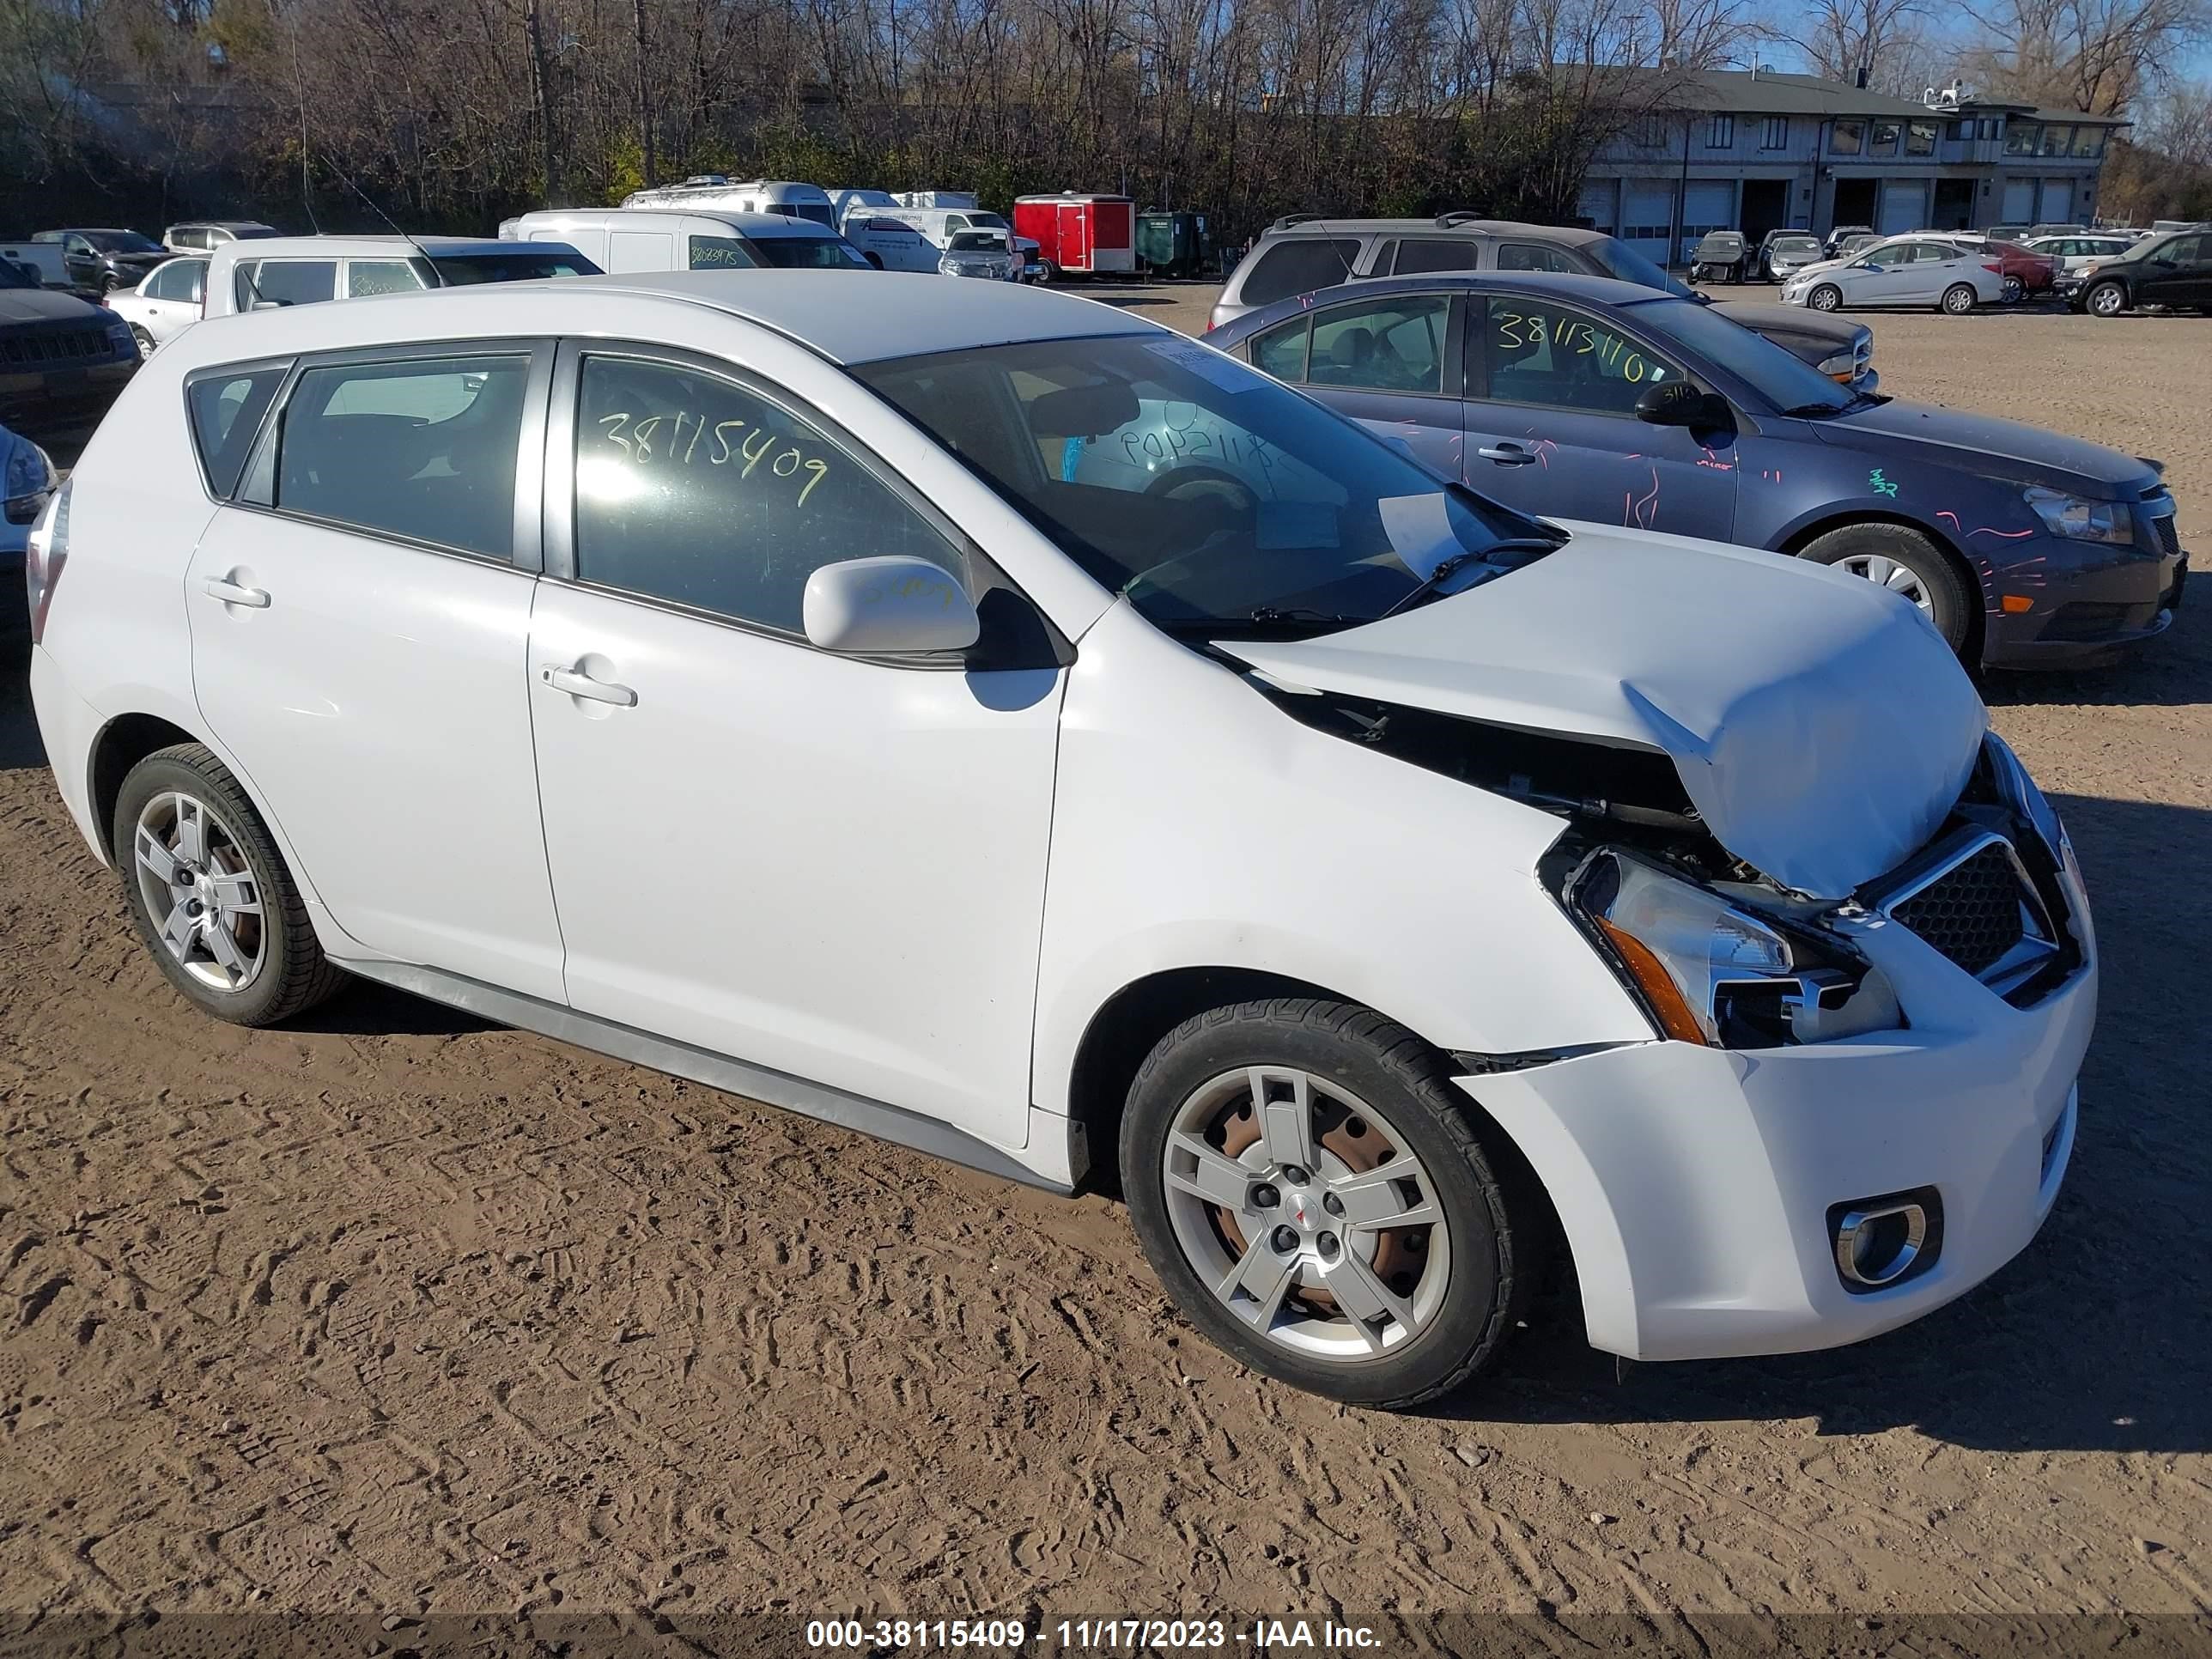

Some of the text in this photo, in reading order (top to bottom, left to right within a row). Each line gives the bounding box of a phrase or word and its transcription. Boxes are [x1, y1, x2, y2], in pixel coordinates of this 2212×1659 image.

[691, 246, 738, 265] 38083975
[1498, 313, 1644, 383] 38113110
[599, 410, 828, 508] 38115409
